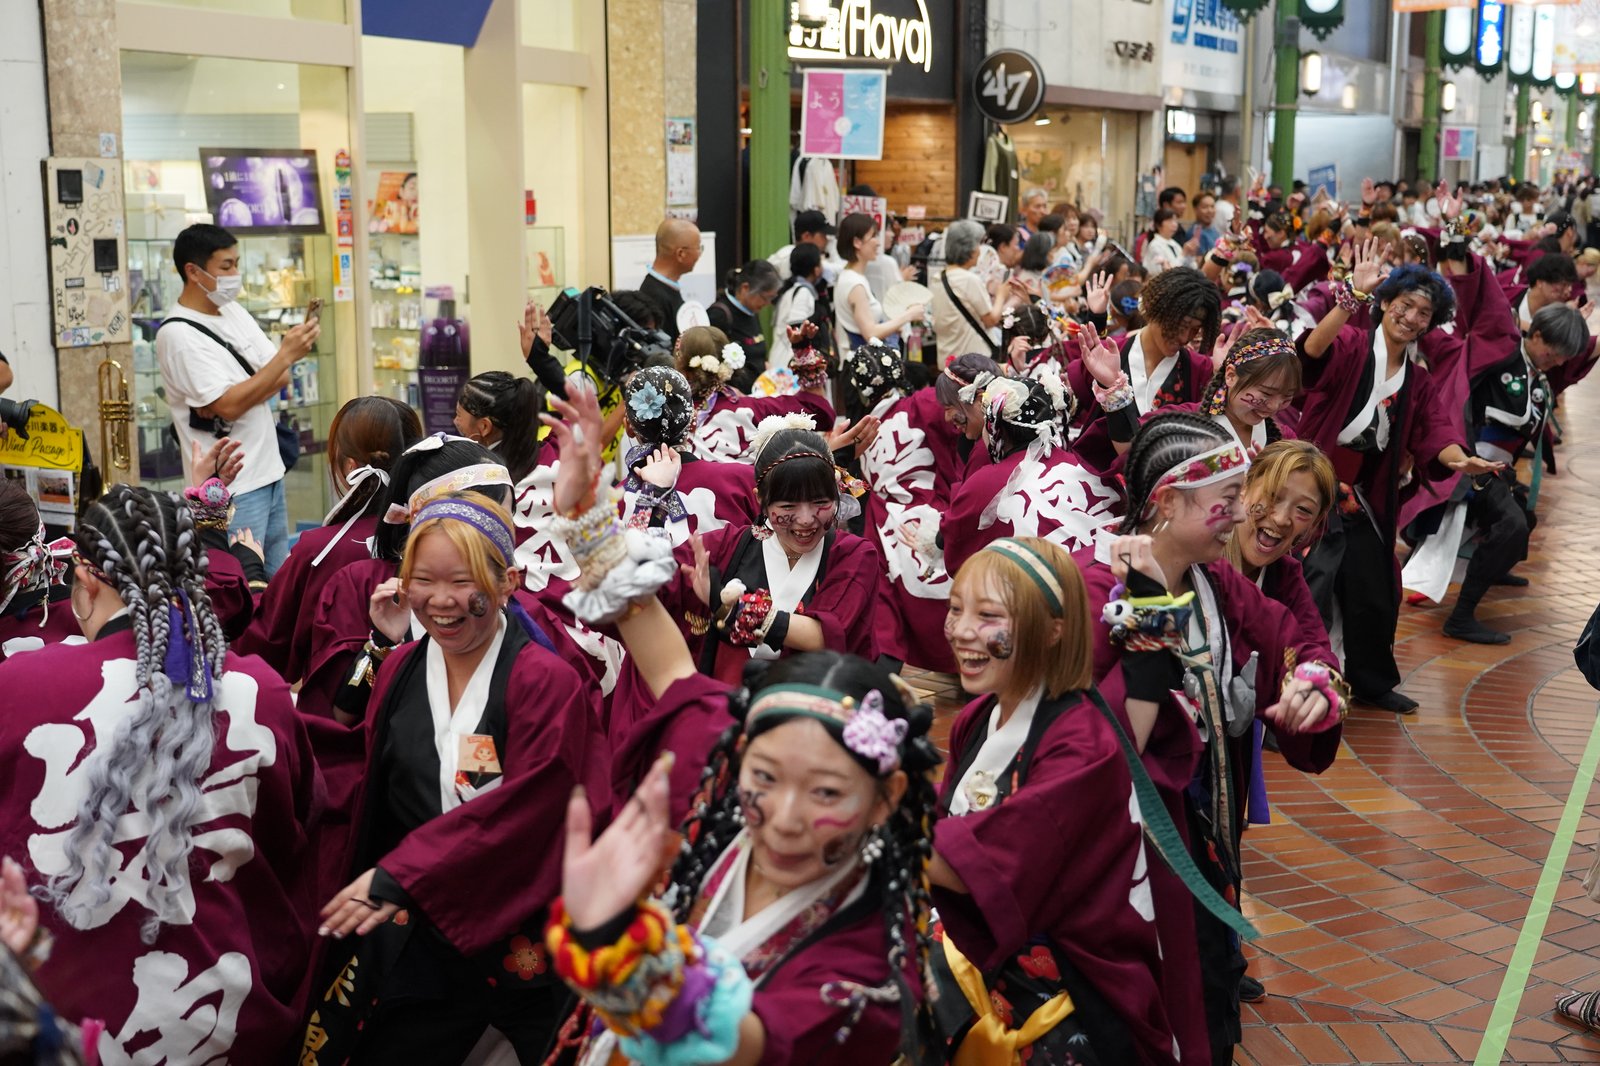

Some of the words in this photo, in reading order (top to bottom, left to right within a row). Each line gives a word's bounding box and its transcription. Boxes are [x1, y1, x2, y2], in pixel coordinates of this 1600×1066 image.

[808, 90, 879, 111] ようこそ
[844, 196, 879, 213] SALE
[0, 435, 27, 453] Wind
[31, 435, 65, 461] Passage
